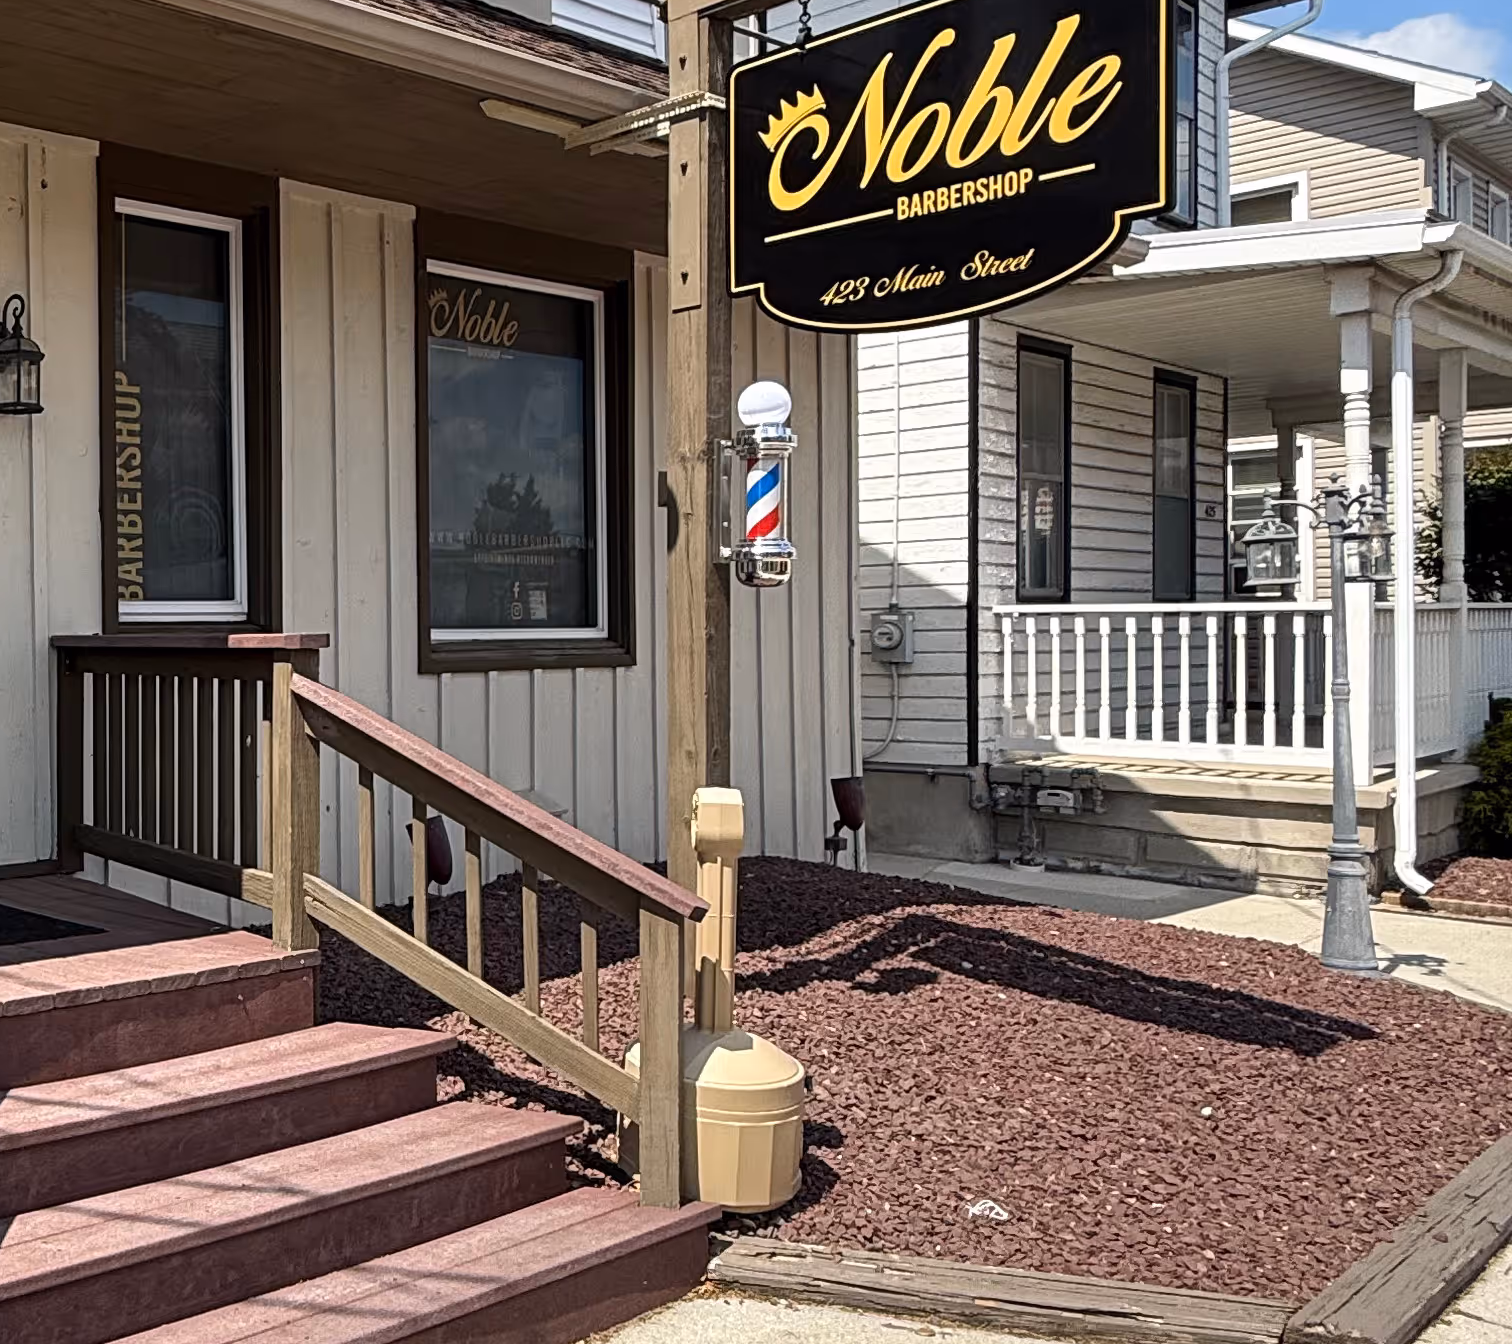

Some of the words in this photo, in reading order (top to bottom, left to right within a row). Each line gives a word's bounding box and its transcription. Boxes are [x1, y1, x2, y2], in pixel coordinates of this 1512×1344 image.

[767, 13, 1123, 212] Noble
[896, 167, 1034, 221] BARBERSHOP
[818, 275, 871, 306] 423
[873, 263, 947, 298] Main
[960, 248, 1036, 281] Street
[430, 288, 519, 347] Noble
